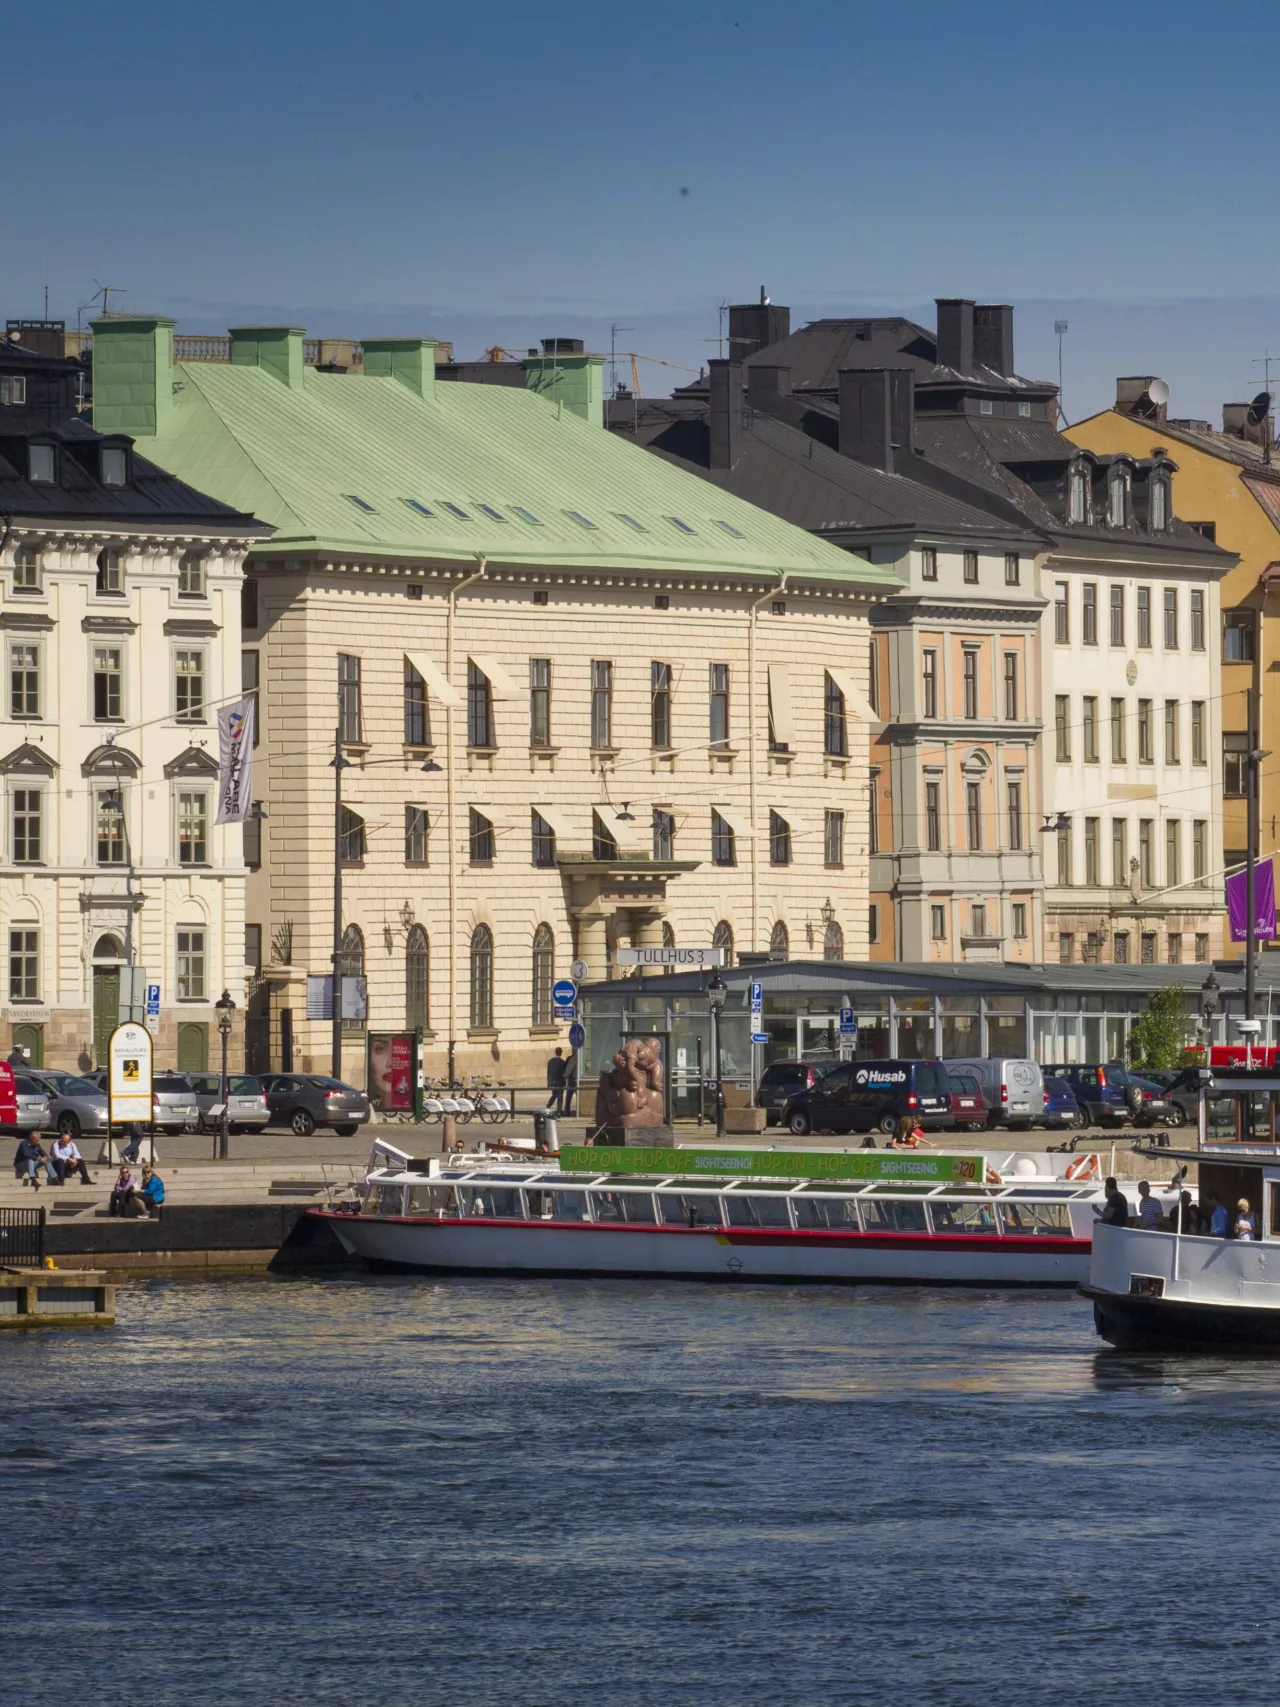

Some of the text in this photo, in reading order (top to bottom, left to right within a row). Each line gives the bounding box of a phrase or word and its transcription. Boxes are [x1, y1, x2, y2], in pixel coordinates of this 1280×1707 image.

[634, 950, 704, 963] TULLHUS 3
[574, 962, 584, 980] 3
[843, 1009, 851, 1022] P
[868, 1070, 906, 1083] Husab
[568, 1149, 597, 1165] HOP
[600, 1150, 621, 1168] ON
[633, 1150, 663, 1168] HOP
[667, 1153, 694, 1169] OFF
[695, 1156, 750, 1170] SIGHTSEEING
[751, 1151, 780, 1170] HOP
[784, 1153, 806, 1173] ON
[818, 1154, 848, 1173] HOP
[852, 1158, 879, 1175] OFF
[881, 1161, 938, 1175] SIGHTSEEING
[959, 1160, 976, 1179] 120
